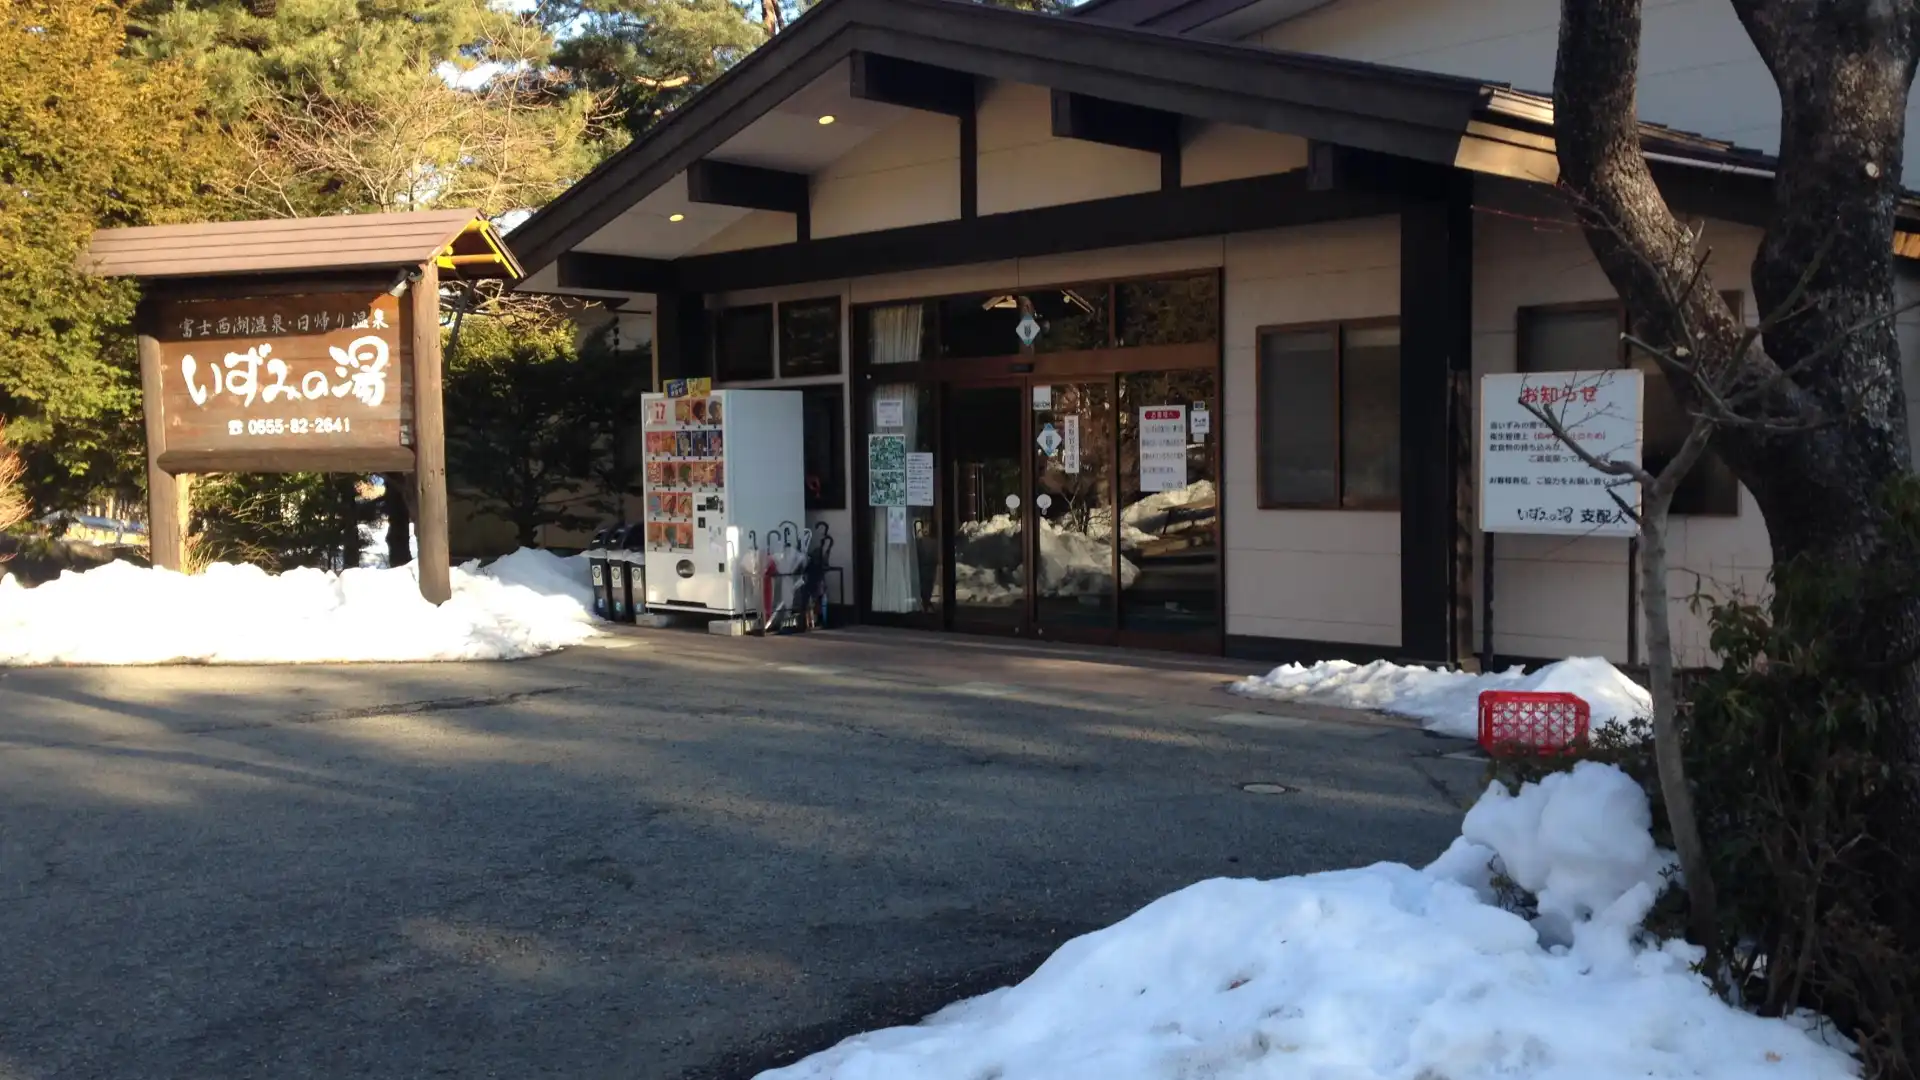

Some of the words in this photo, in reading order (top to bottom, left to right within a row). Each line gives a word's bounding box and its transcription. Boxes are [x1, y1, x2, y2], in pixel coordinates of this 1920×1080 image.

[181, 335, 390, 407] いずみの湯
[1522, 385, 1599, 403] お知らせ
[248, 417, 350, 435] 0555-82-2641
[1581, 508, 1628, 525] 支配人
